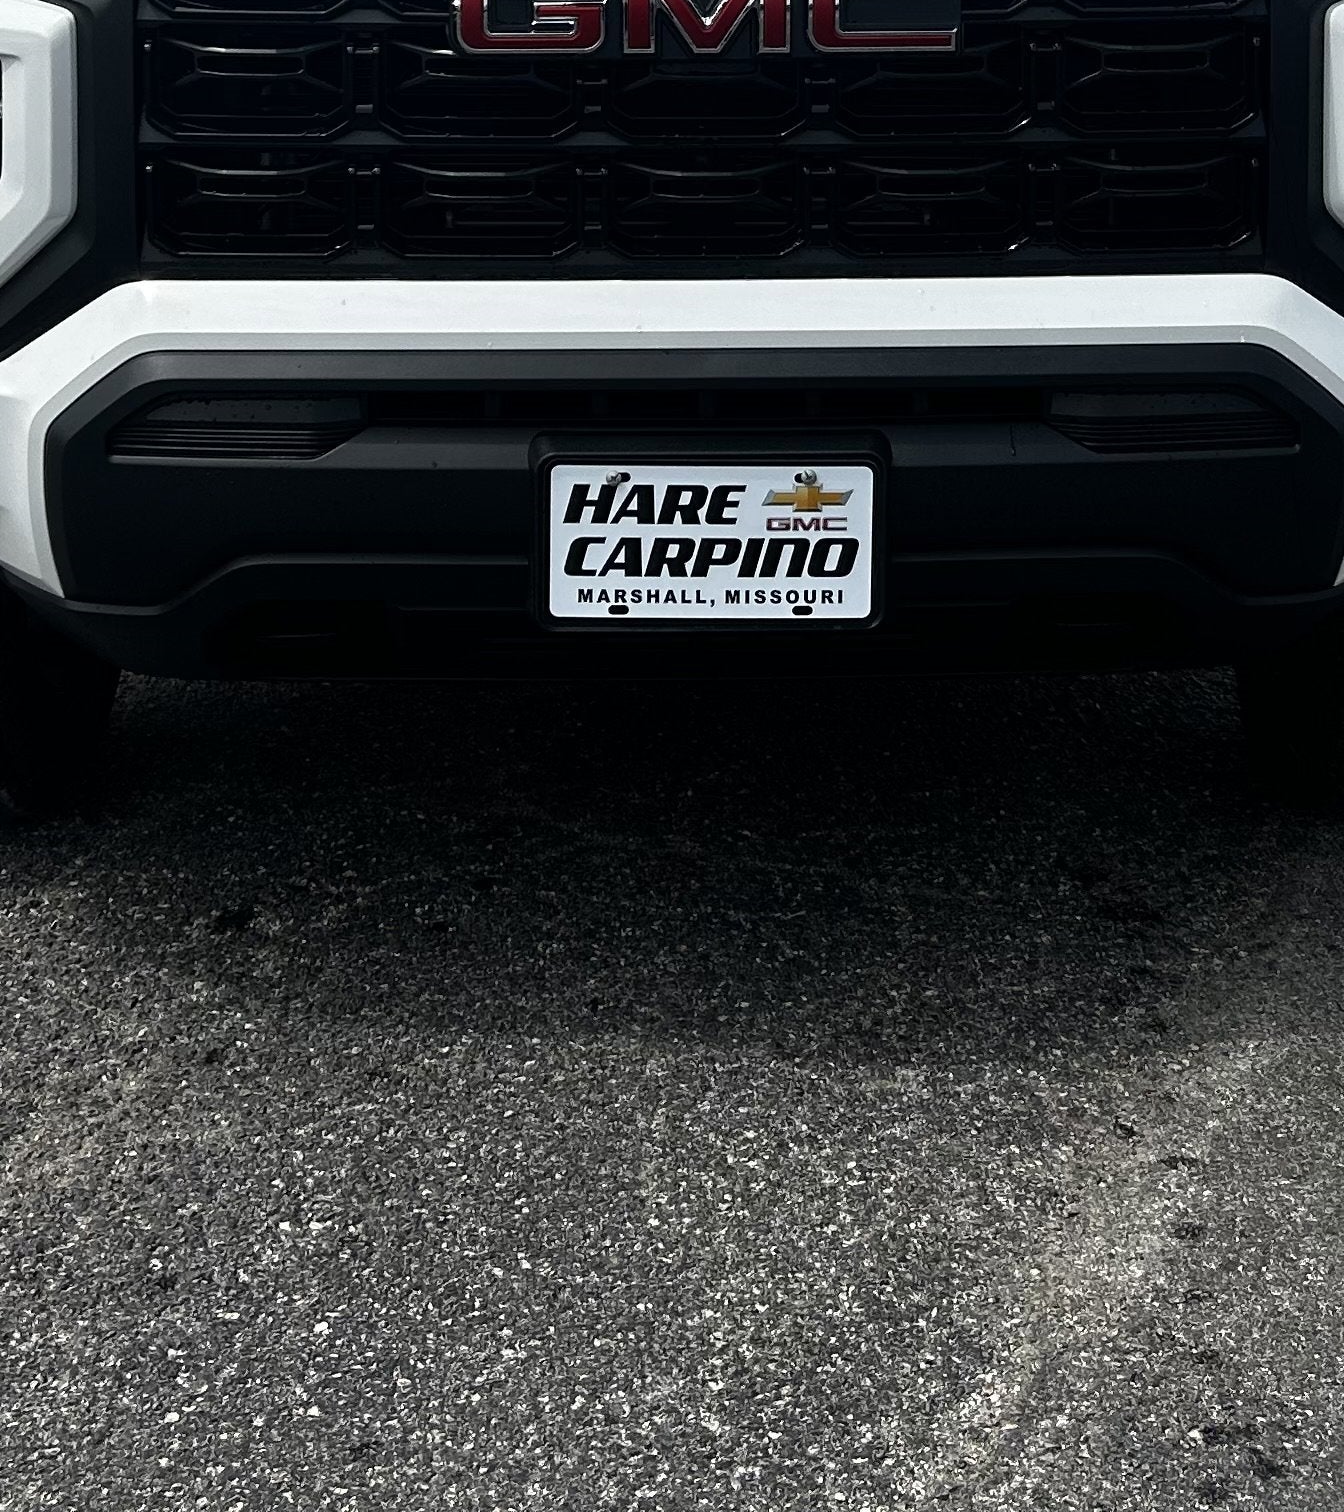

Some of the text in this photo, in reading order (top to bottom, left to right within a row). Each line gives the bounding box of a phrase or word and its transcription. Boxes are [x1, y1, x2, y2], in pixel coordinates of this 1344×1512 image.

[562, 484, 748, 525] HARE
[765, 516, 848, 532] GMC
[562, 536, 860, 579] CARPINO
[577, 588, 844, 607] MARSHALL, MISSOURI
